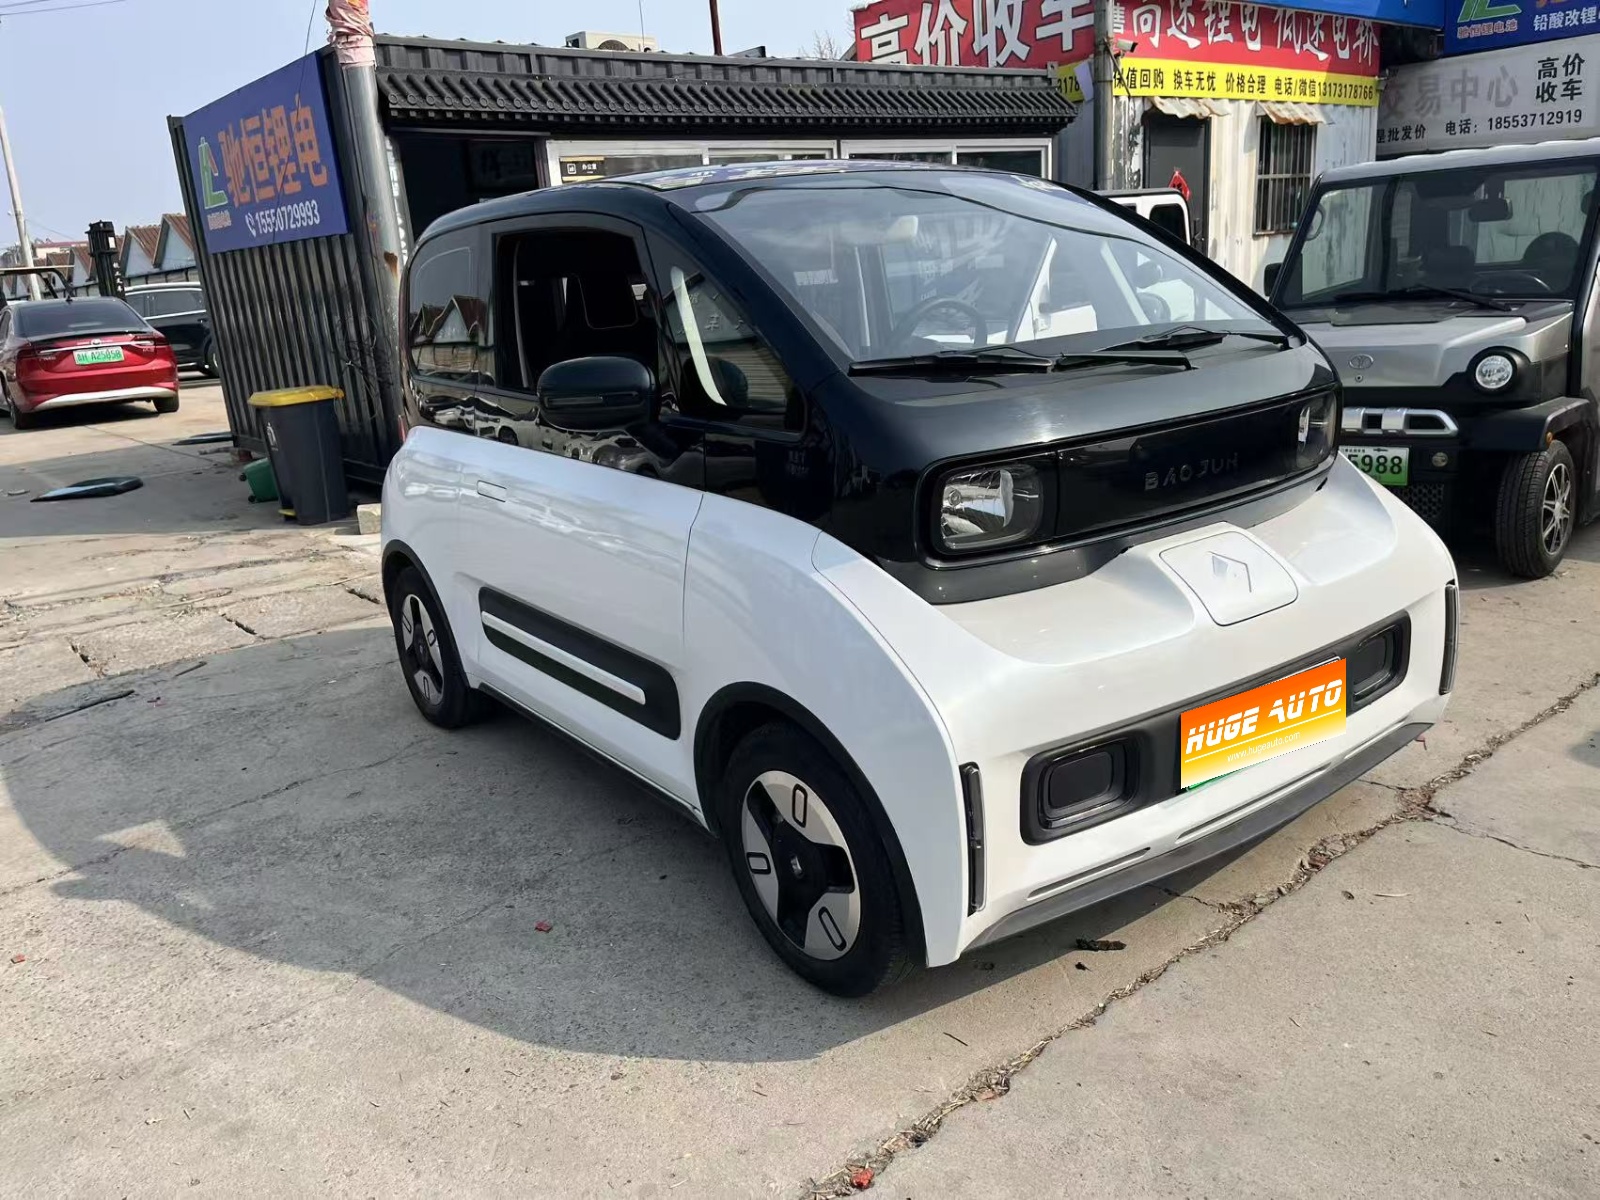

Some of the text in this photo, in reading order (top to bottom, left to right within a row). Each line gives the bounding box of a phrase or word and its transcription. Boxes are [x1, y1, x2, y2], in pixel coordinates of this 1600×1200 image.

[1533, 6, 1600, 31] 铅酸改锂
[860, 0, 1094, 68] 高价收车
[1537, 53, 1585, 79] 高价
[1173, 70, 1216, 92] 换车无忧
[1225, 72, 1266, 95] 价格合理
[1535, 78, 1583, 103] 收车
[1487, 109, 1582, 131] 18553712919
[255, 199, 320, 234] 15550729993
